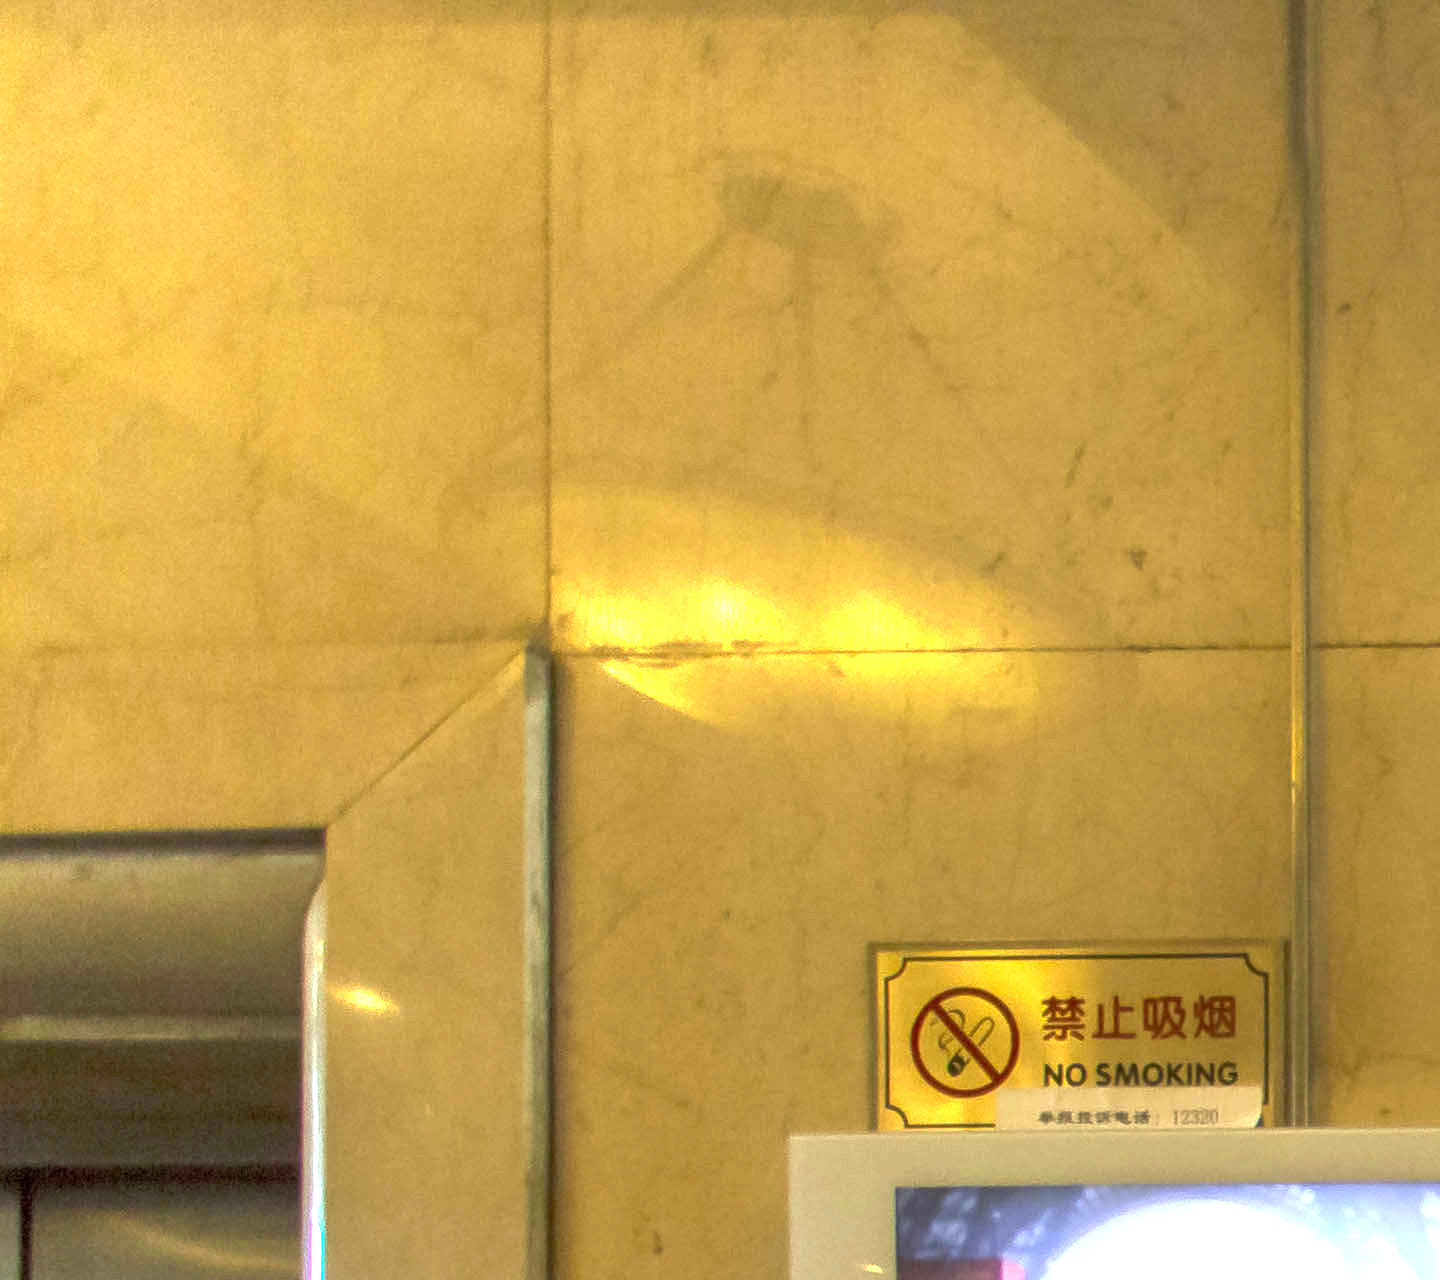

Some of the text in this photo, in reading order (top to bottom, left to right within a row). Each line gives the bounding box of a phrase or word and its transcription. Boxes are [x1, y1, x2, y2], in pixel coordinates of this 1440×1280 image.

[1041, 994, 1237, 1041] 禁止吸烟
[1043, 1061, 1239, 1088] NO SMOKING
